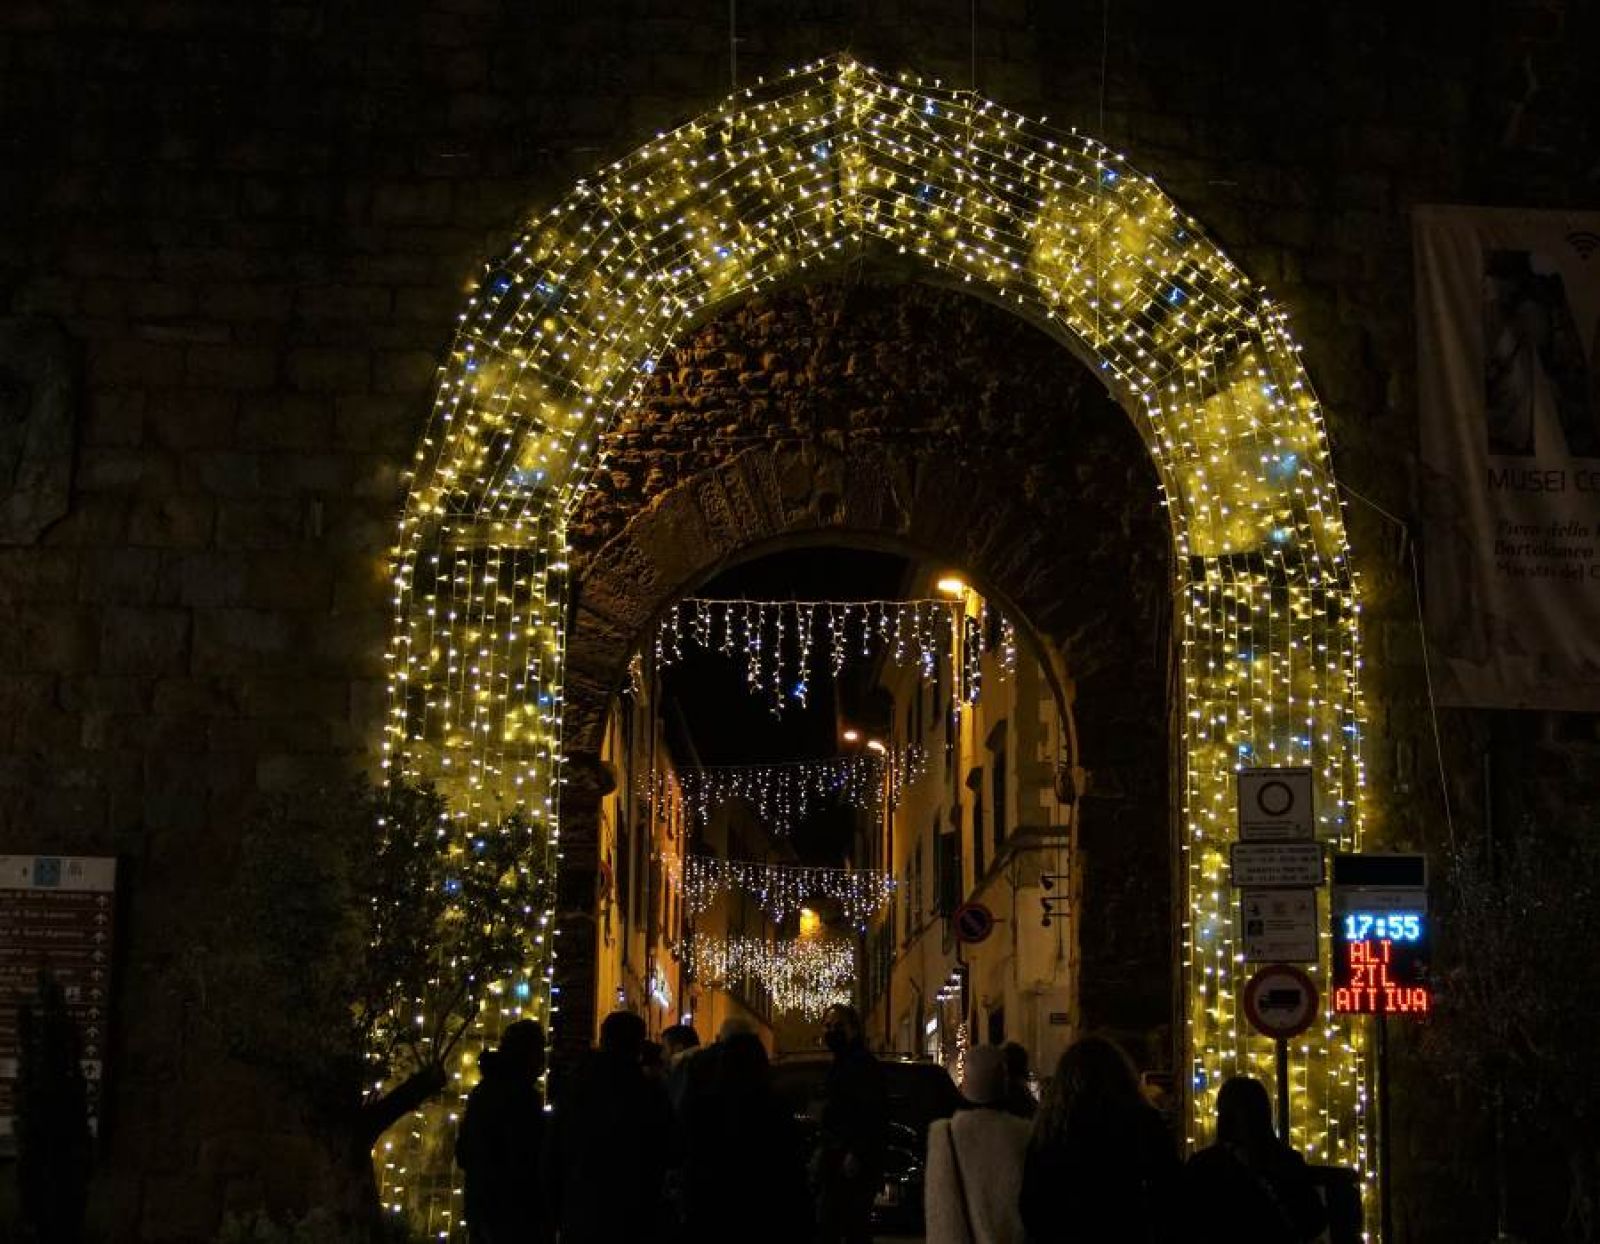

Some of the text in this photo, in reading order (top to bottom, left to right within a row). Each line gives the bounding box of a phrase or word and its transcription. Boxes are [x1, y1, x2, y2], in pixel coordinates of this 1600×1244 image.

[1488, 468, 1566, 493] MUSEI
[1345, 914, 1421, 940] 17:55
[1350, 940, 1393, 963] ALT
[1350, 964, 1396, 987] ZTL
[1336, 987, 1428, 1012] ATTIVA
